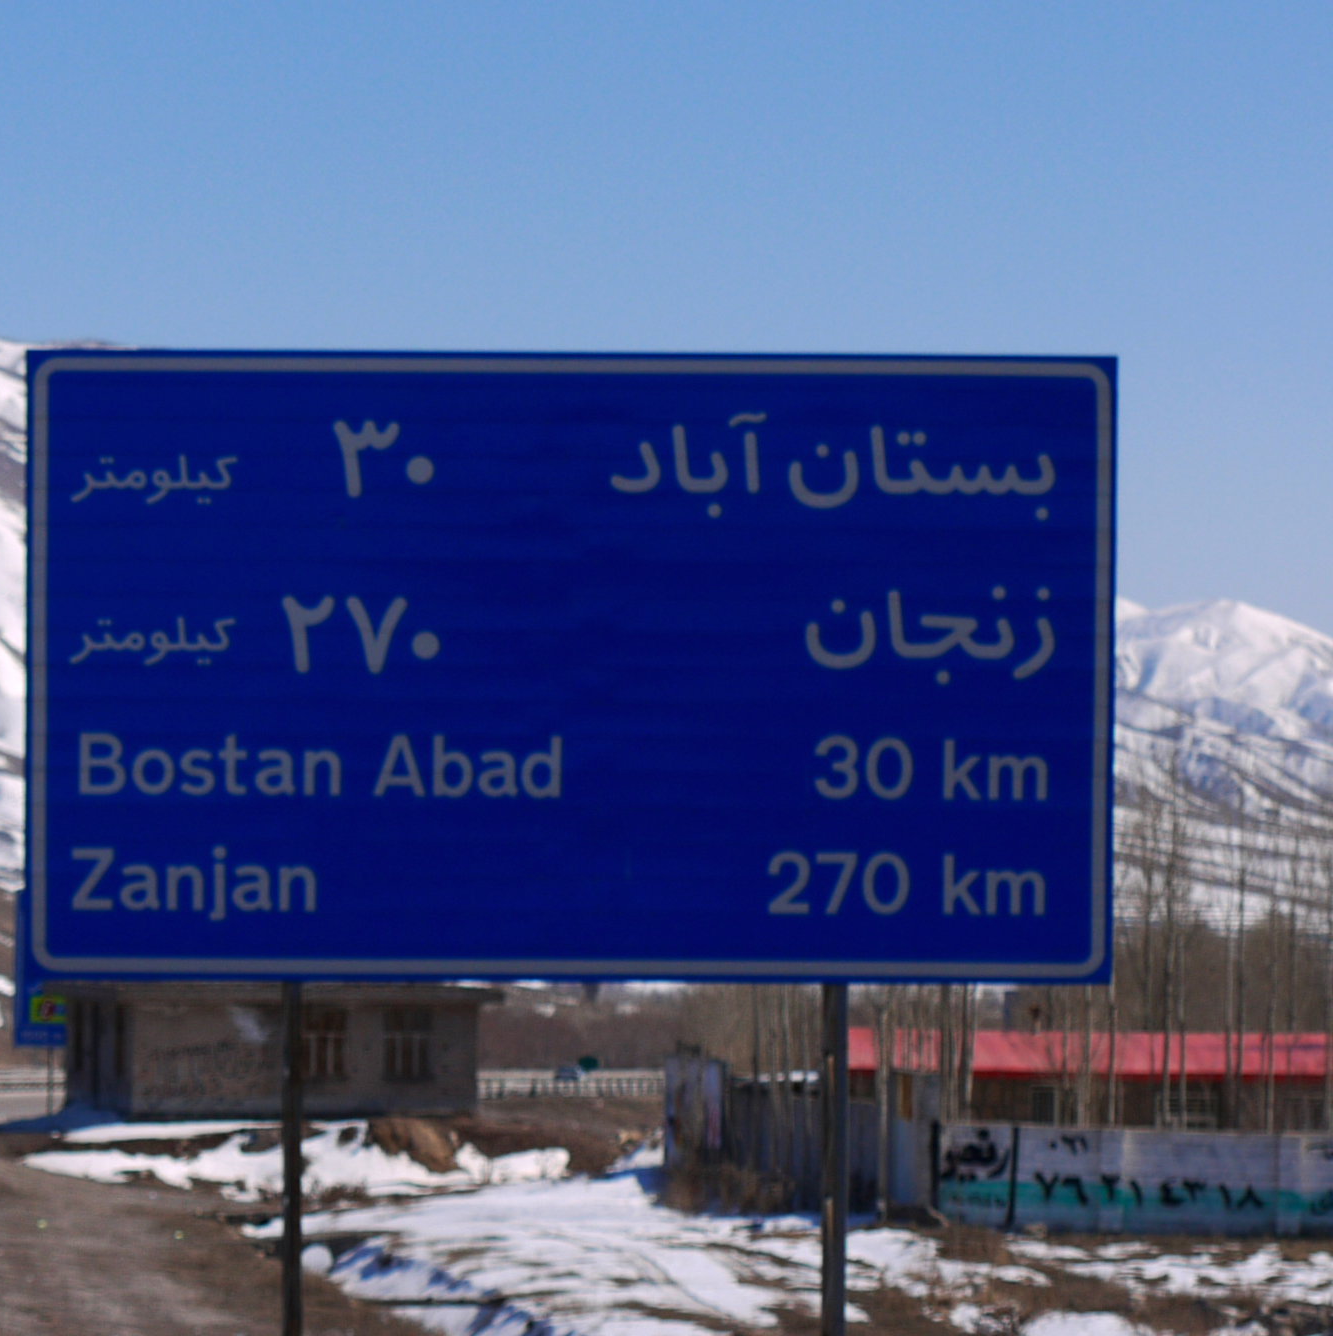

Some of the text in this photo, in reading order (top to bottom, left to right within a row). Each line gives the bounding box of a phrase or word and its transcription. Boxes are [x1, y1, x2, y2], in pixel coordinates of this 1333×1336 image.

[70, 411, 1056, 521] بستان آباد ۳۰ کیلومتر
[69, 585, 1055, 685] زنجان ۲۷۰ کیلومتر
[78, 731, 1048, 801] Bostan Abad 30 km
[71, 845, 1045, 921] Zanjan 270 km
